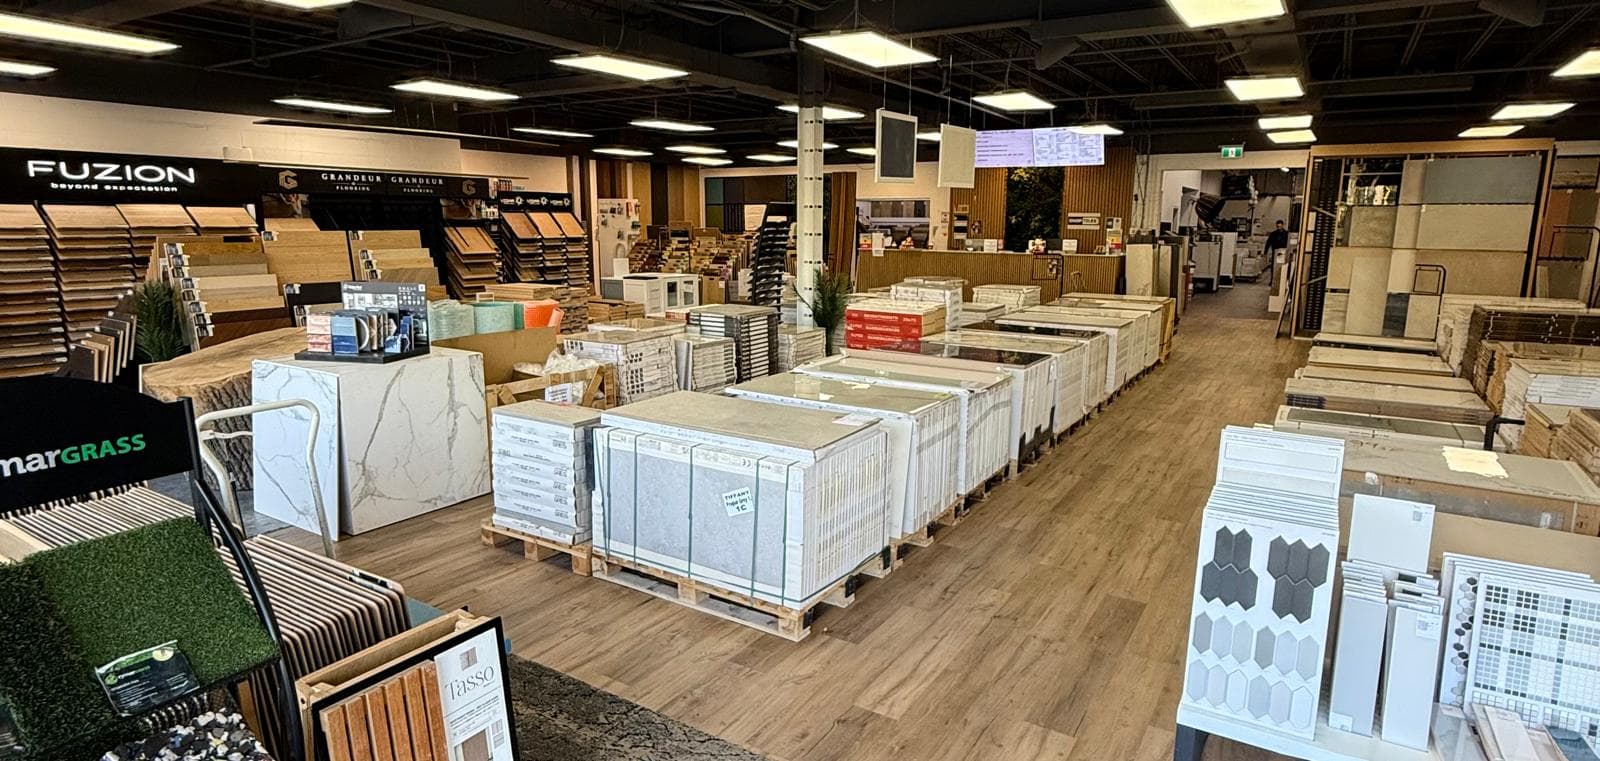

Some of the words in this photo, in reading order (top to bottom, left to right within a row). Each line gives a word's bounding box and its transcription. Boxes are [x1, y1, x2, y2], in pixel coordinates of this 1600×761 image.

[27, 160, 195, 184] FUZION
[321, 173, 382, 183] GRANDEUR
[391, 176, 443, 185] GRANDEUR
[50, 182, 99, 190] beyond
[444, 665, 494, 700] Tasso
